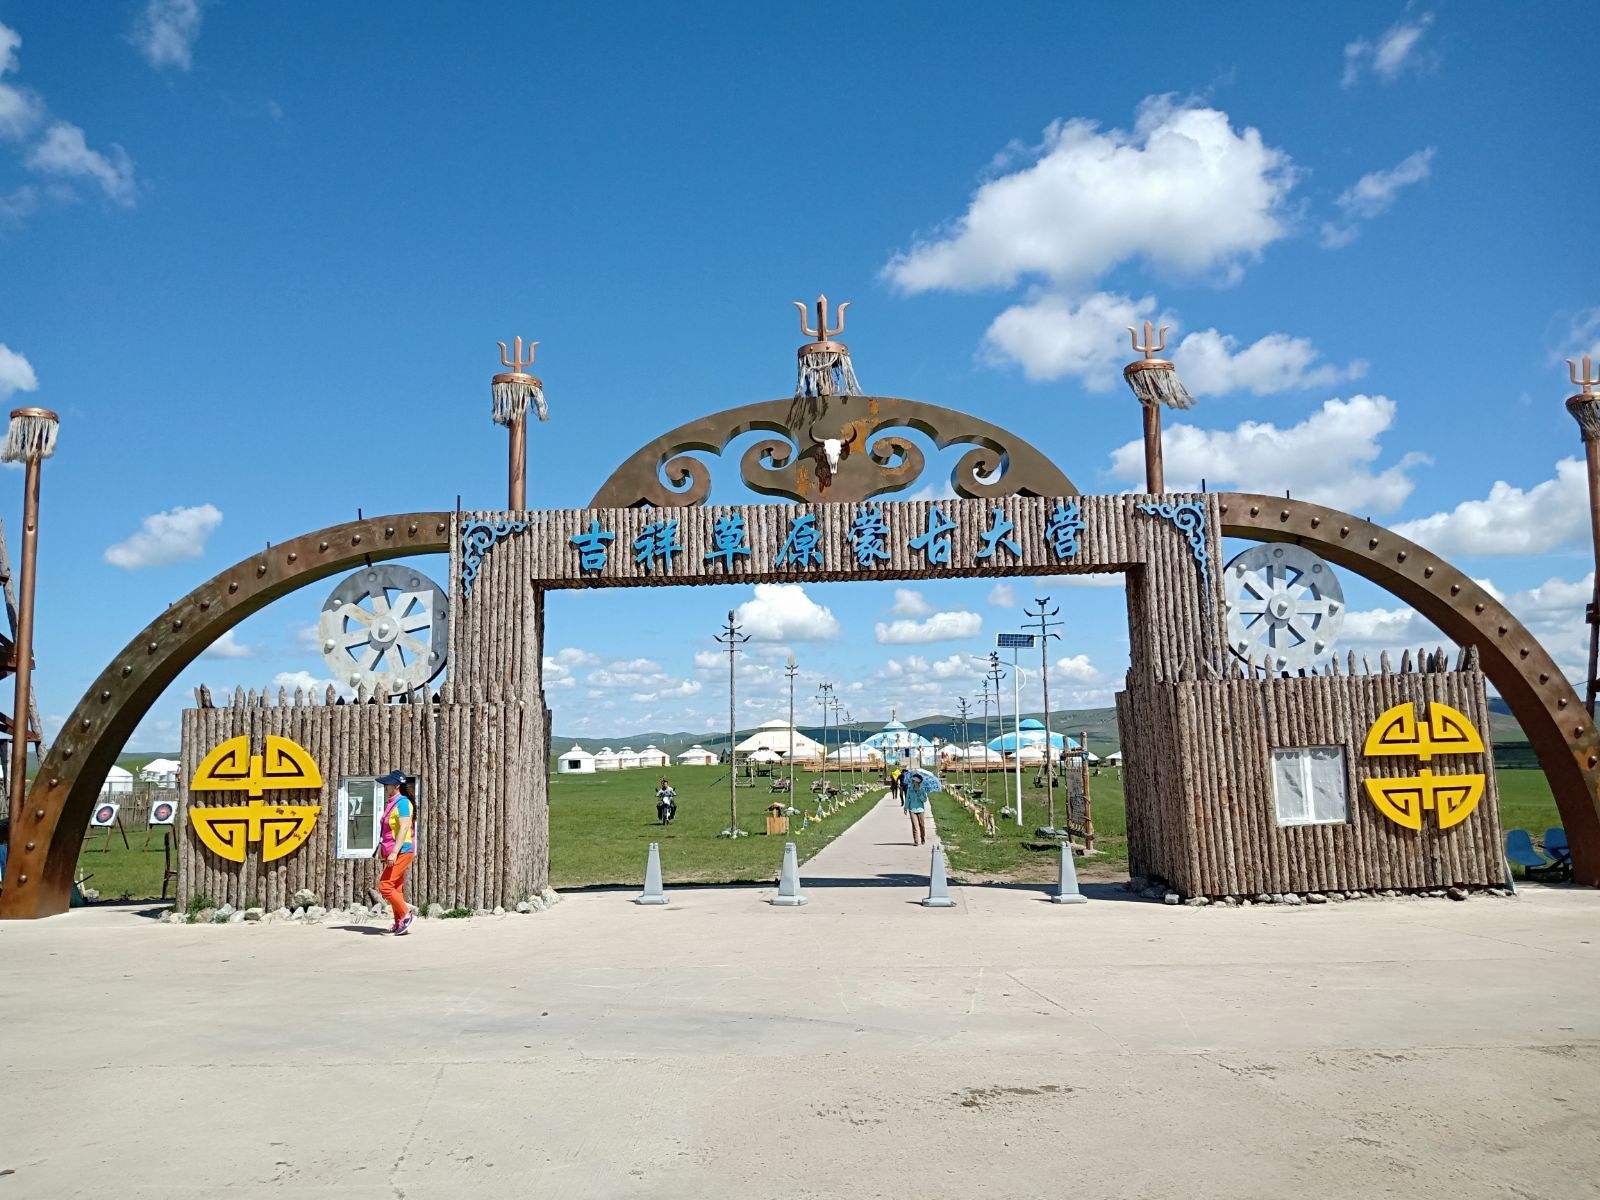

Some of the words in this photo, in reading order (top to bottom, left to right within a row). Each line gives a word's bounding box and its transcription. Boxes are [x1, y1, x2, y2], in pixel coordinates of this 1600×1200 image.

[569, 501, 1086, 572] 吉祥草原蒙古大营
